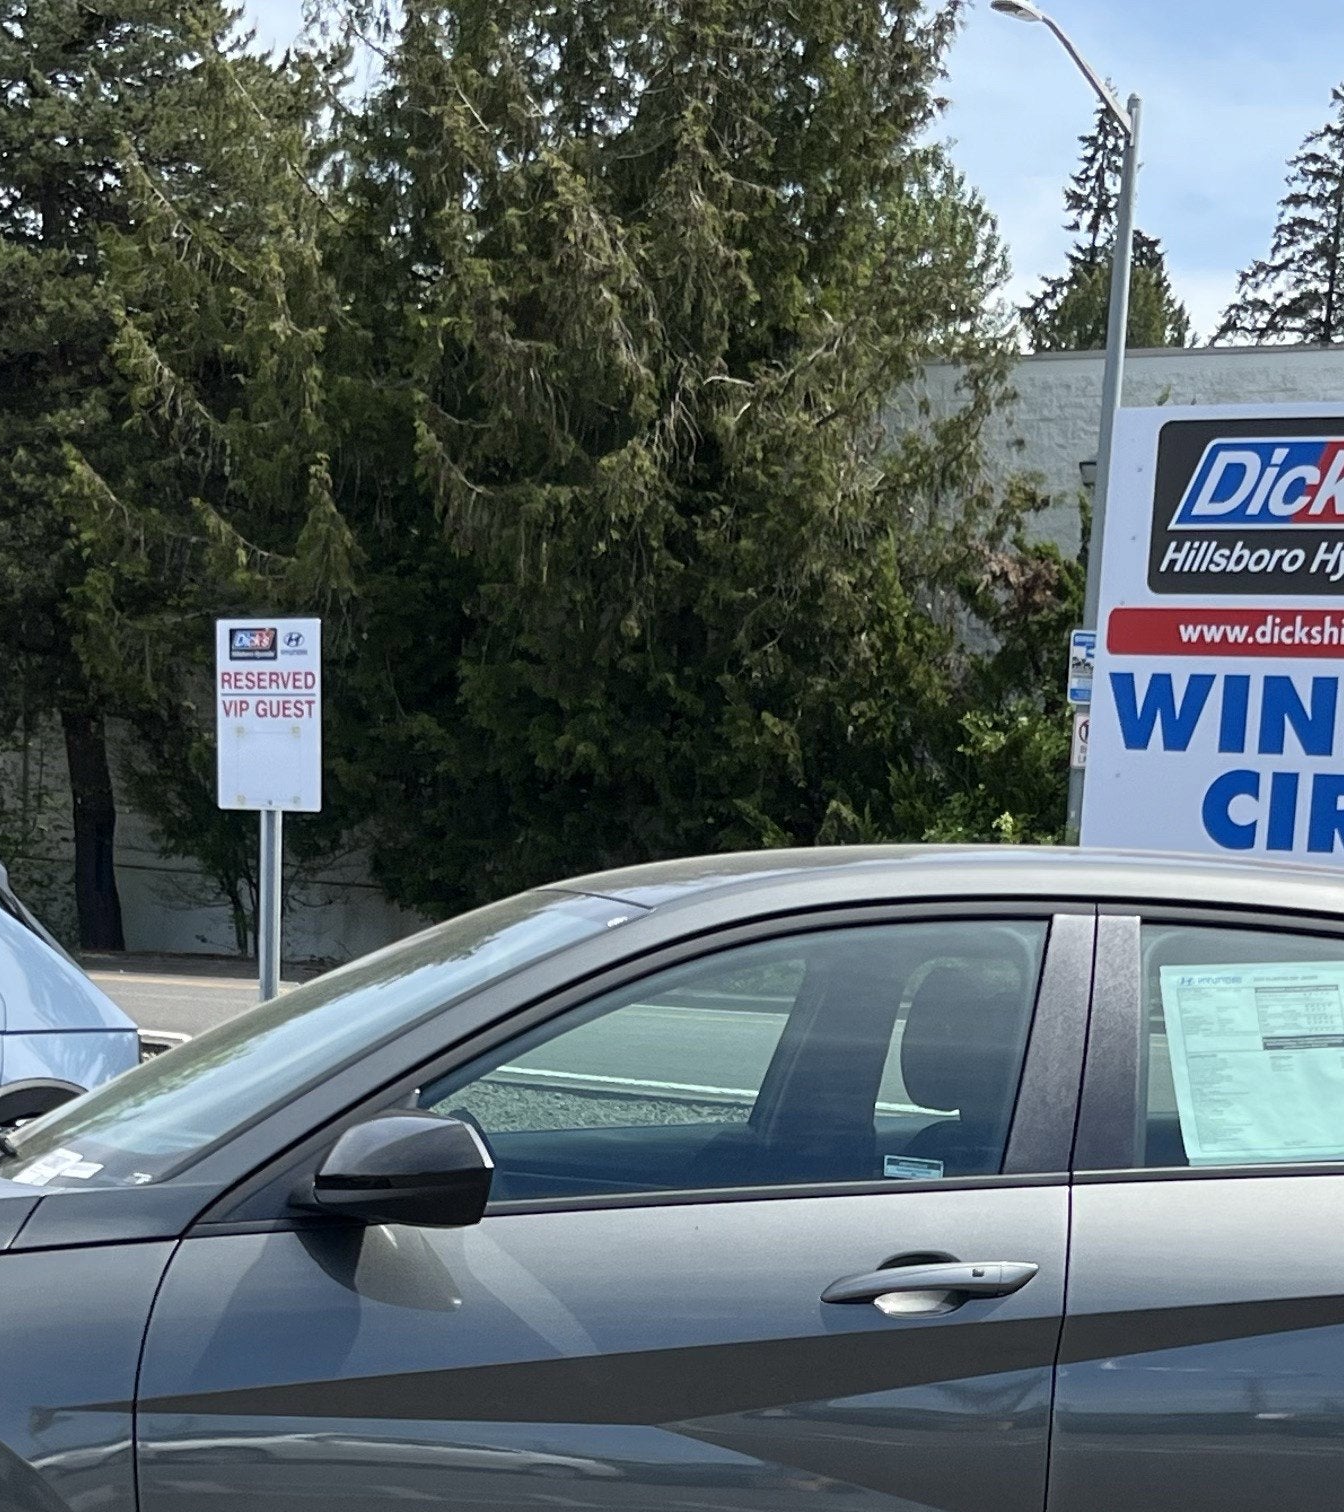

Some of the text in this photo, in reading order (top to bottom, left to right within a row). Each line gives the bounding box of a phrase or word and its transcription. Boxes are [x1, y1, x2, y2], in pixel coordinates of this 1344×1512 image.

[1159, 541, 1305, 573] Hillsboro
[221, 671, 316, 690] RESERVED
[222, 700, 316, 719] VIP GUEST
